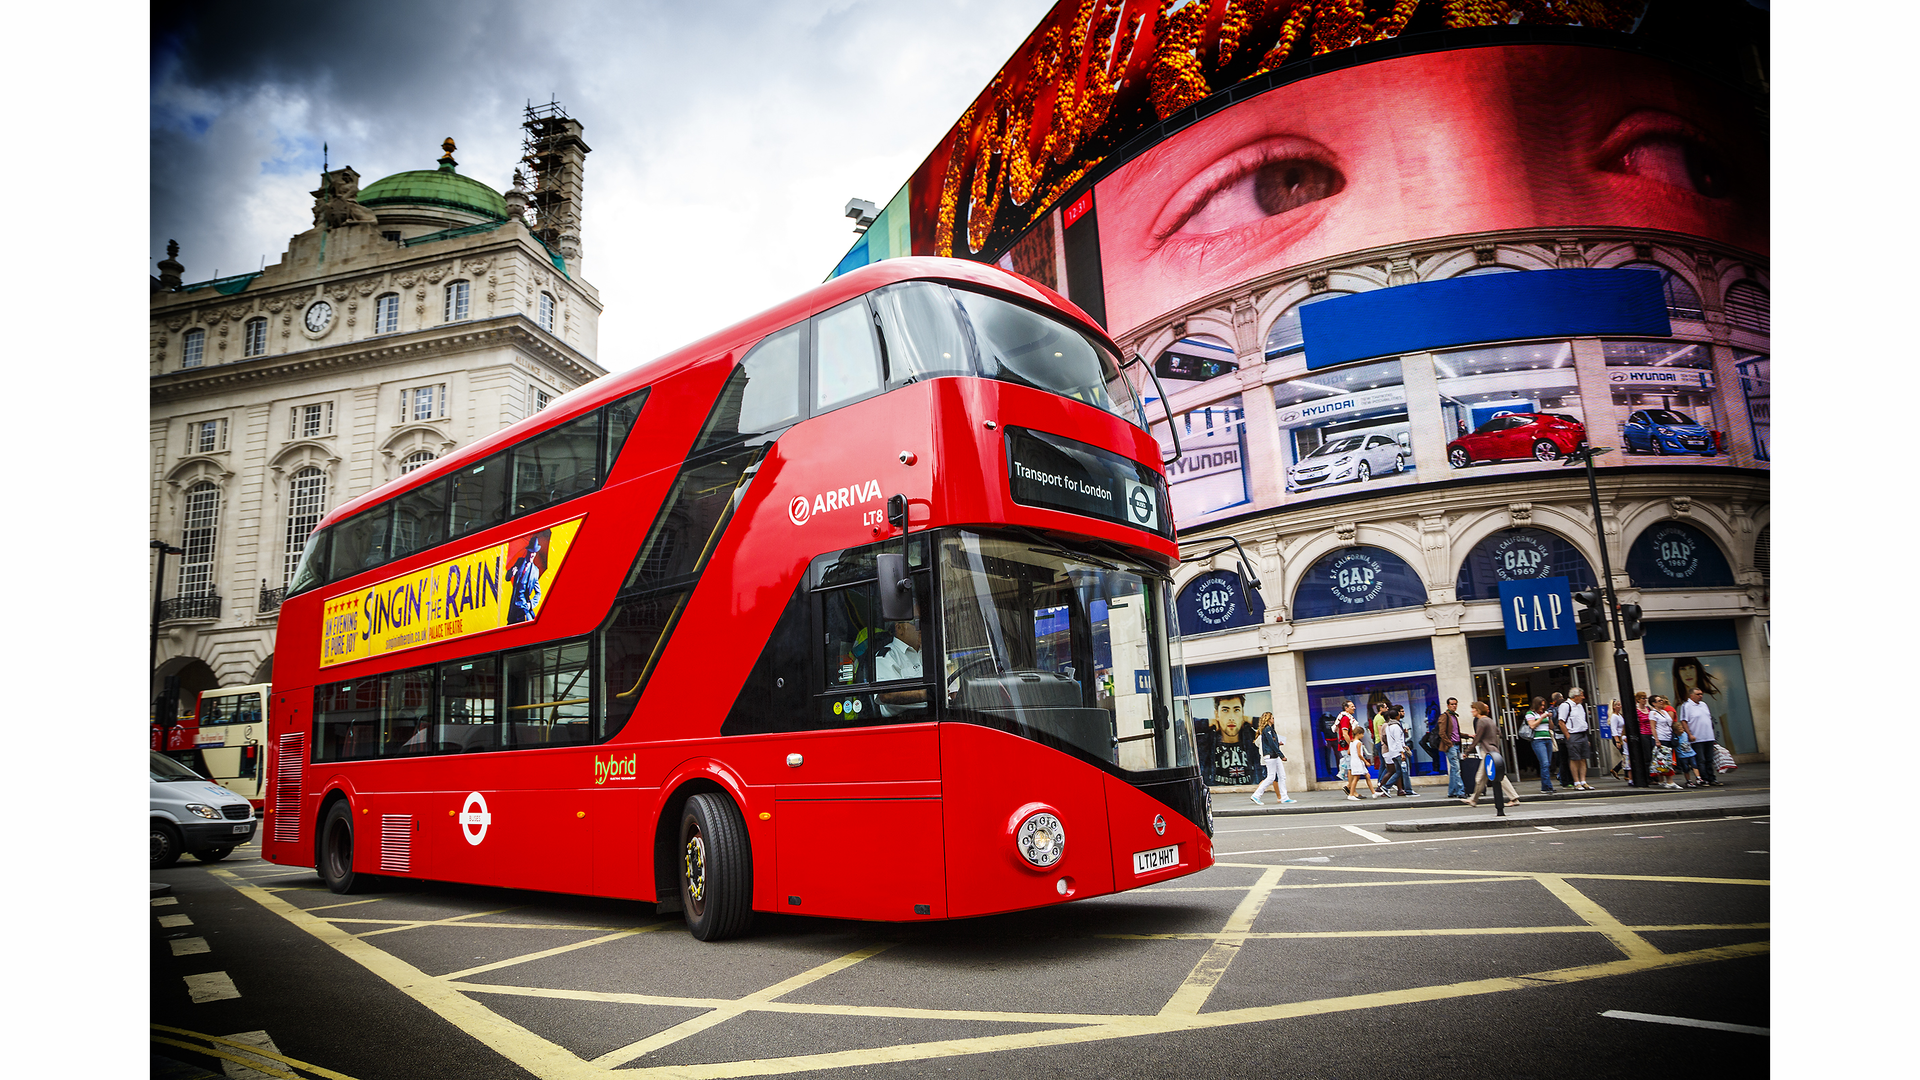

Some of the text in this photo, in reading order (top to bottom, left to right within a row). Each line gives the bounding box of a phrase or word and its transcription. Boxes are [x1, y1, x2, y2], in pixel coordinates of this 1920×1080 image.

[515, 355, 540, 376] ALLIANCE
[544, 373, 555, 385] LIFE
[1630, 372, 1676, 381] HYUNDAI
[1302, 399, 1355, 417] HYUNDAI
[1015, 462, 1112, 501] Transport for London
[812, 479, 882, 515] ARRIVA
[863, 509, 883, 526] LT8
[1505, 550, 1541, 570] GAP
[1538, 545, 1549, 557] USA
[1662, 541, 1690, 560] GAP
[1339, 567, 1374, 588] GAP
[1371, 561, 1381, 574] USA
[362, 577, 428, 640] SINGIN'
[426, 598, 441, 620] THE
[445, 556, 500, 620] RAIN
[1226, 585, 1234, 596] USA
[1331, 580, 1383, 604] LONDON EDITION
[1346, 584, 1368, 593] 1969
[1202, 590, 1229, 610] GAP
[1208, 606, 1224, 614] 1969
[1197, 603, 1235, 624] LONDON EDITION
[1513, 593, 1562, 632] GAP
[333, 611, 358, 635] EVENING
[429, 624, 443, 639] PALACE
[444, 619, 463, 636] THEATRE
[331, 635, 344, 656] PURE
[595, 753, 636, 785] hybrid
[1139, 849, 1173, 870] LT12 HHT
